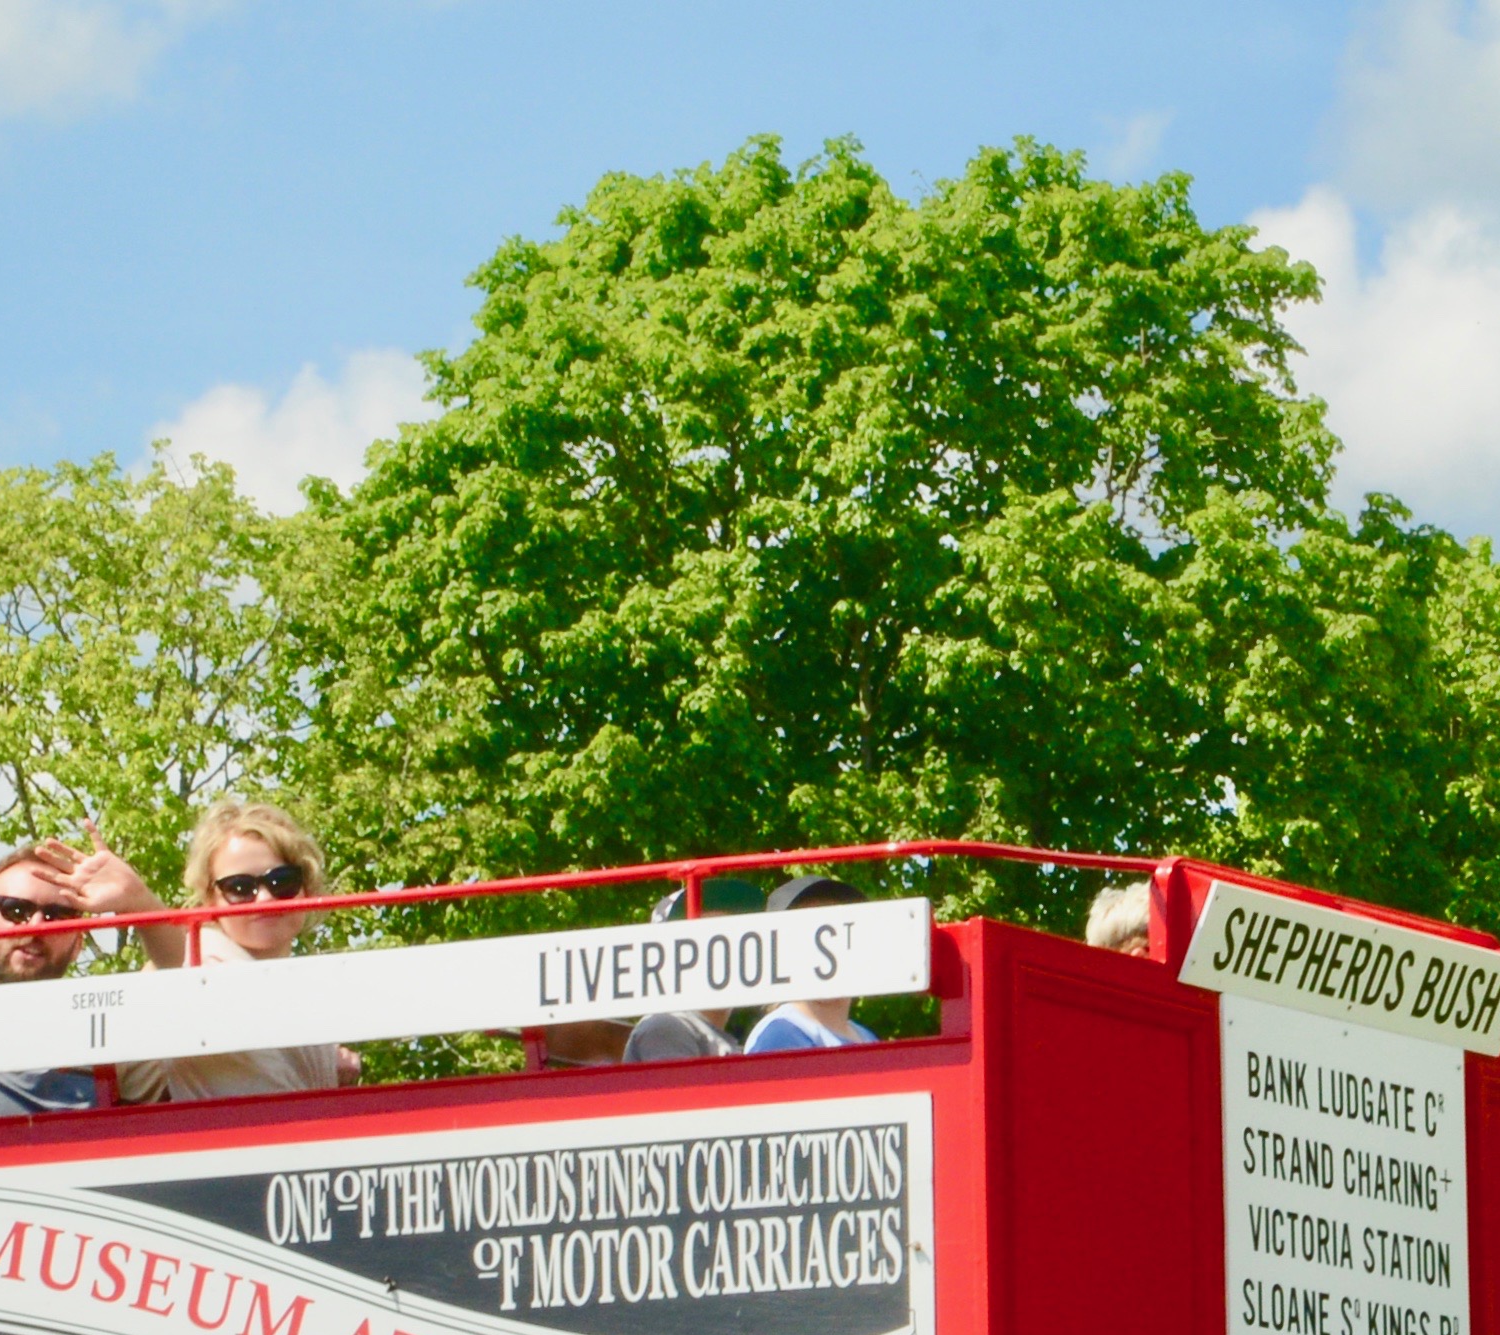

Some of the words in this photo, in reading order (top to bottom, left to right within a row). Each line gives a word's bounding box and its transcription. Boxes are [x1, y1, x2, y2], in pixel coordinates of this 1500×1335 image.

[72, 990, 124, 1010] SERVICE
[539, 930, 790, 1007] LIVERPOOL
[1213, 908, 1415, 1012] SHEPHERDS
[1248, 1051, 1308, 1110] BANK
[1318, 1067, 1415, 1134] LUDGATE
[267, 1171, 332, 1245] ONE
[334, 1168, 378, 1238] OF
[380, 1163, 444, 1236] THE
[578, 1144, 684, 1221] FINEST
[687, 1125, 902, 1214] COLLECTIONS
[1243, 1127, 1333, 1189] STRAND
[473, 1236, 523, 1310] OF
[530, 1224, 678, 1309] MOTOR
[684, 1207, 902, 1298] CARRIAGES
[1249, 1204, 1353, 1270] VICTORIA
[1363, 1227, 1450, 1288] STATION
